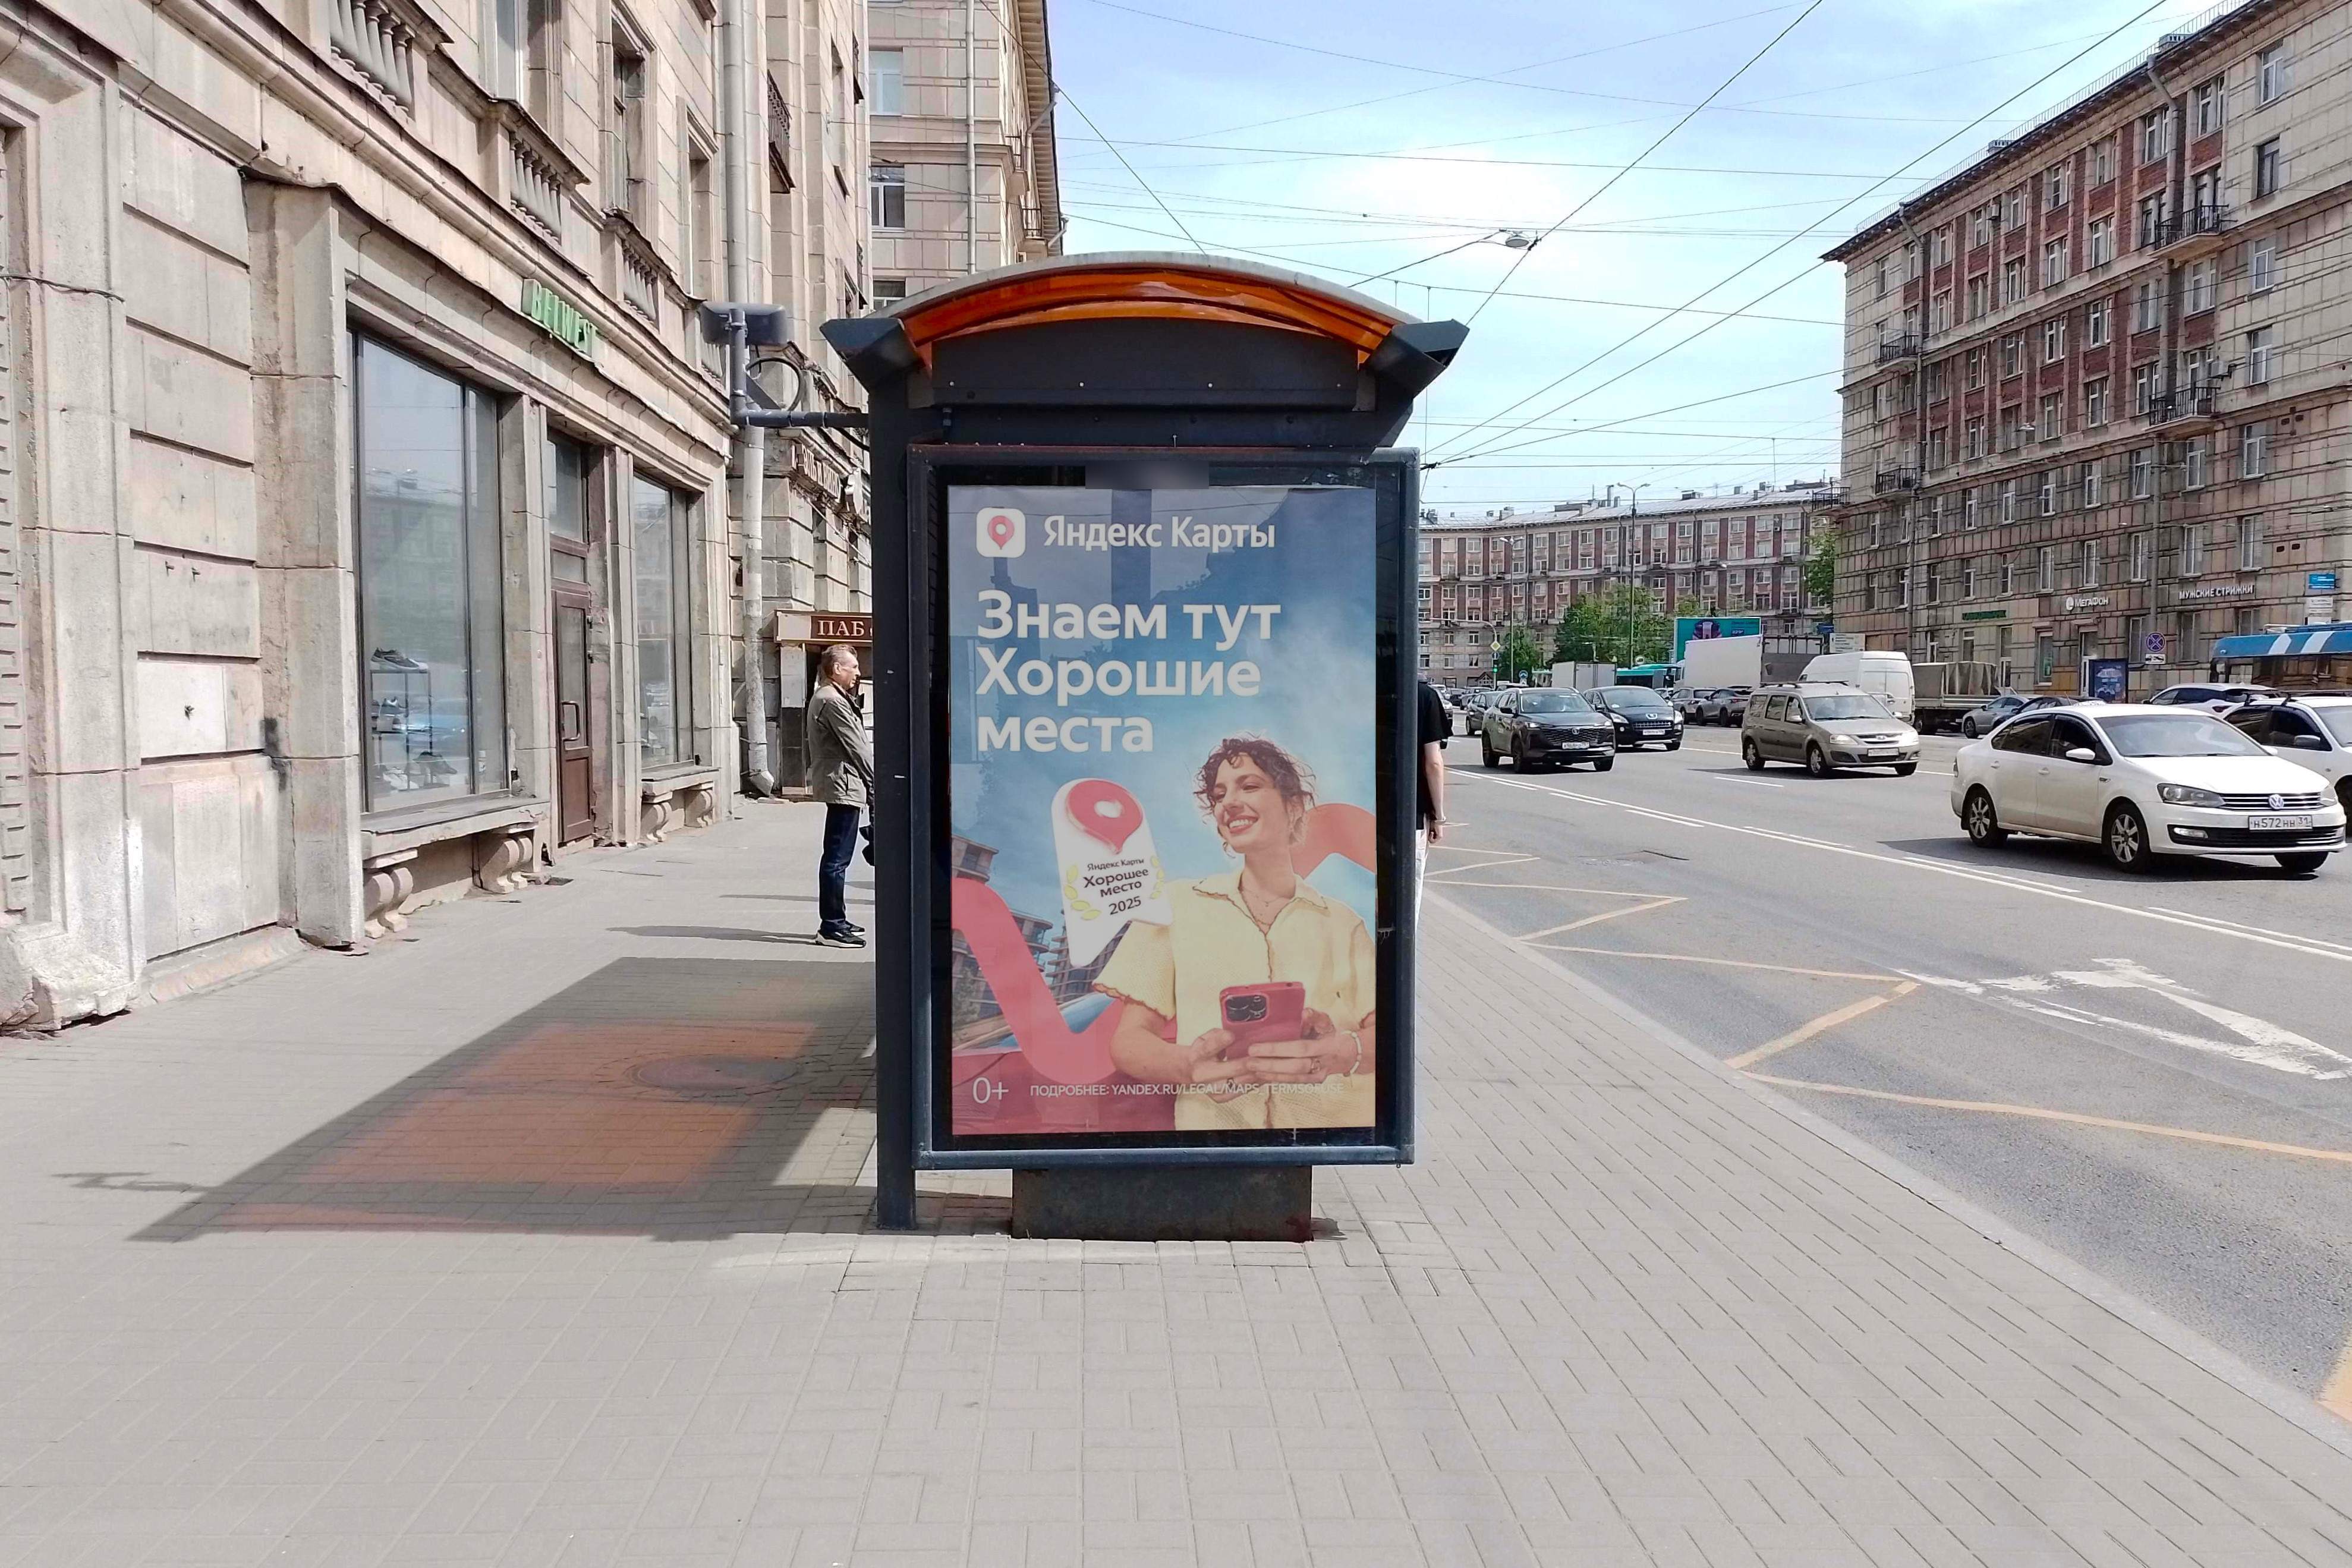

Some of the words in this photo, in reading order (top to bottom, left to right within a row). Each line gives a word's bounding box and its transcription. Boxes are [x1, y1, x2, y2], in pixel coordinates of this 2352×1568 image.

[522, 279, 598, 357] BELWEST
[1044, 515, 1162, 550] Яндекс
[1171, 517, 1275, 553] Карты
[2178, 588, 2215, 600] МУЖСКИЕ
[2215, 585, 2254, 597] СТРИЖКИ
[817, 620, 865, 637] ПАБ
[977, 590, 1167, 639] Знаем
[1183, 604, 1281, 651] тут
[976, 647, 1261, 706] Хорошие
[978, 716, 1153, 752] места
[1087, 862, 1120, 871] Яндекс
[1083, 868, 1149, 888] Хорошее
[1100, 881, 1142, 898] место
[1109, 896, 1142, 915] 2025
[972, 1077, 1009, 1104] 0+
[1030, 1084, 1109, 1097] ПОДРОБНЕЕ:
